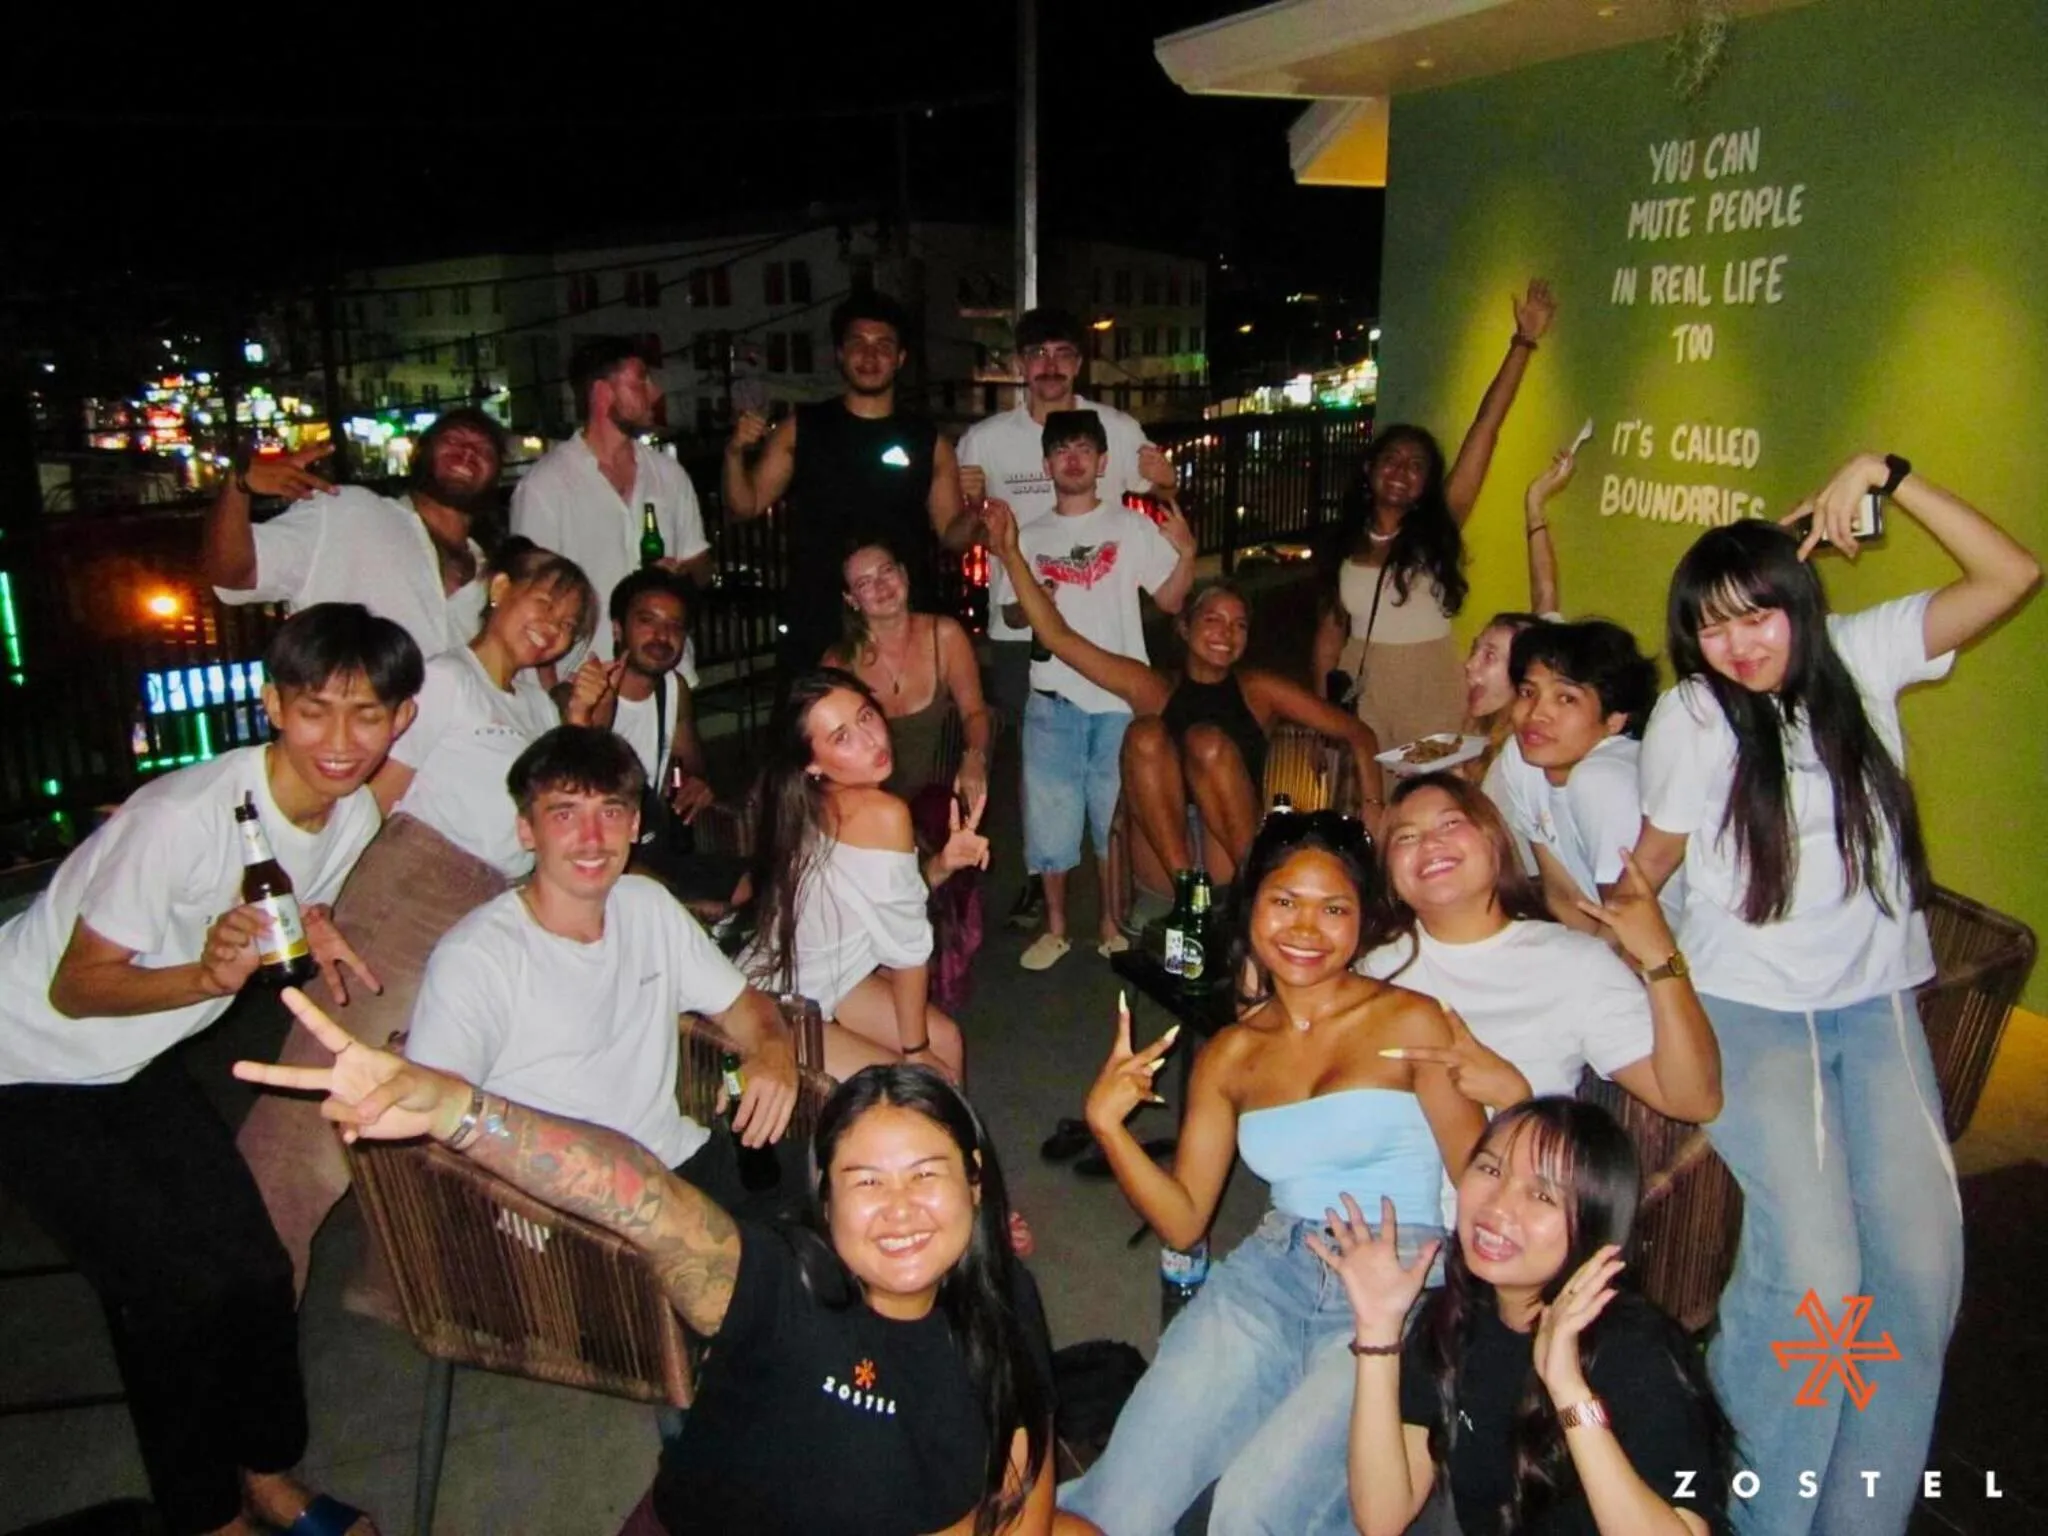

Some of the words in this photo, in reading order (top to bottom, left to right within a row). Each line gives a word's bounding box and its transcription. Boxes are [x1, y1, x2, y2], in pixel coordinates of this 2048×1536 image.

[1650, 138, 1695, 184] YOU
[1703, 127, 1761, 180] CAN
[1627, 197, 1695, 241] MUTE
[1706, 184, 1806, 234] PEOPLE
[1611, 267, 1637, 306] IN
[1650, 264, 1712, 307] REAL
[1723, 254, 1789, 304] LIFE
[1673, 323, 1714, 364] TOO
[1611, 418, 1654, 459] IT'S
[1670, 423, 1761, 469] CALLED
